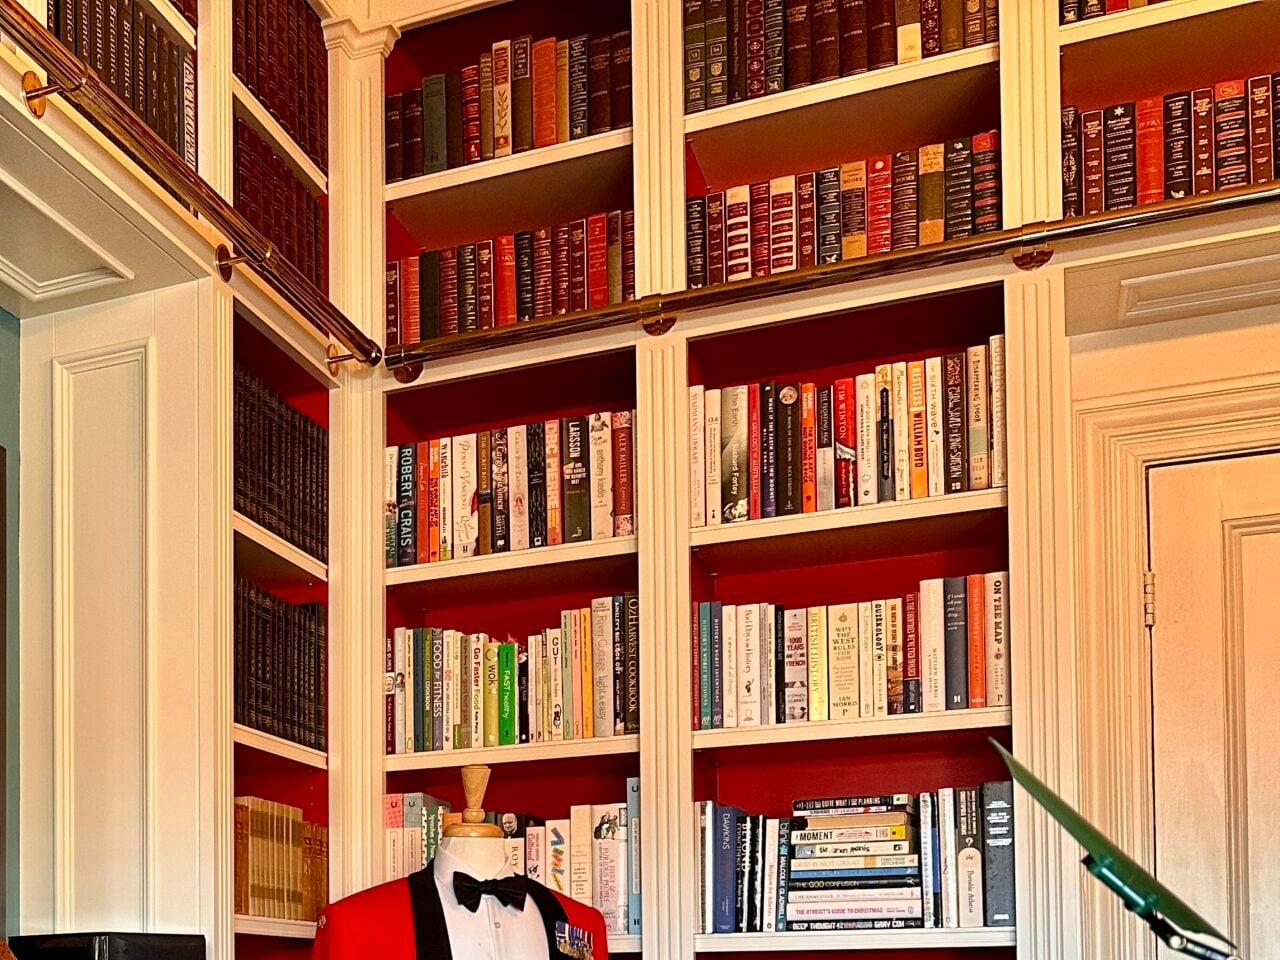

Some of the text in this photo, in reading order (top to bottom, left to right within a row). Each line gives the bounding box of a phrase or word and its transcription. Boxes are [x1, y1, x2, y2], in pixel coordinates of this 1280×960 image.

[109, 4, 117, 85] Britannica
[123, 20, 131, 98] Britannica
[972, 359, 982, 423] DISAPPEARING SPOON
[731, 393, 739, 427] The Earth
[838, 384, 847, 439] TIM WINTON
[911, 367, 924, 468] RESTLESS WILLIAM BOYD
[930, 403, 938, 428] wave
[569, 421, 581, 458] LARSSON
[459, 441, 471, 510] PENNY VINCENZI
[595, 449, 606, 477] anthony
[619, 454, 627, 484] MILLER
[949, 451, 963, 478] SWEDEN
[400, 448, 413, 547] ROBERT CRAIS
[730, 472, 739, 495] Fortey
[875, 603, 883, 652] QUIRKOLOGY
[993, 580, 1003, 644] ON THE MAP
[473, 647, 480, 660] Go
[810, 612, 819, 693] BRITISH HISTORY
[832, 637, 856, 645] WEST
[433, 639, 442, 717] FOOD FITNESS
[473, 661, 481, 687] Faster
[488, 664, 498, 686] wok
[595, 615, 608, 721] River Cottage light easy
[628, 660, 638, 713] COOKBOOK
[502, 692, 510, 719] healthy
[722, 813, 730, 850] DAWKINS
[779, 822, 789, 845] blink
[799, 831, 834, 841] MOMENT
[511, 846, 519, 869] ROY
[809, 880, 825, 888] GOD
[778, 888, 786, 920] GLADWELL
[792, 922, 808, 930] DEEP
[810, 922, 836, 930] THOUGHT
[874, 920, 905, 929] GARY COX
